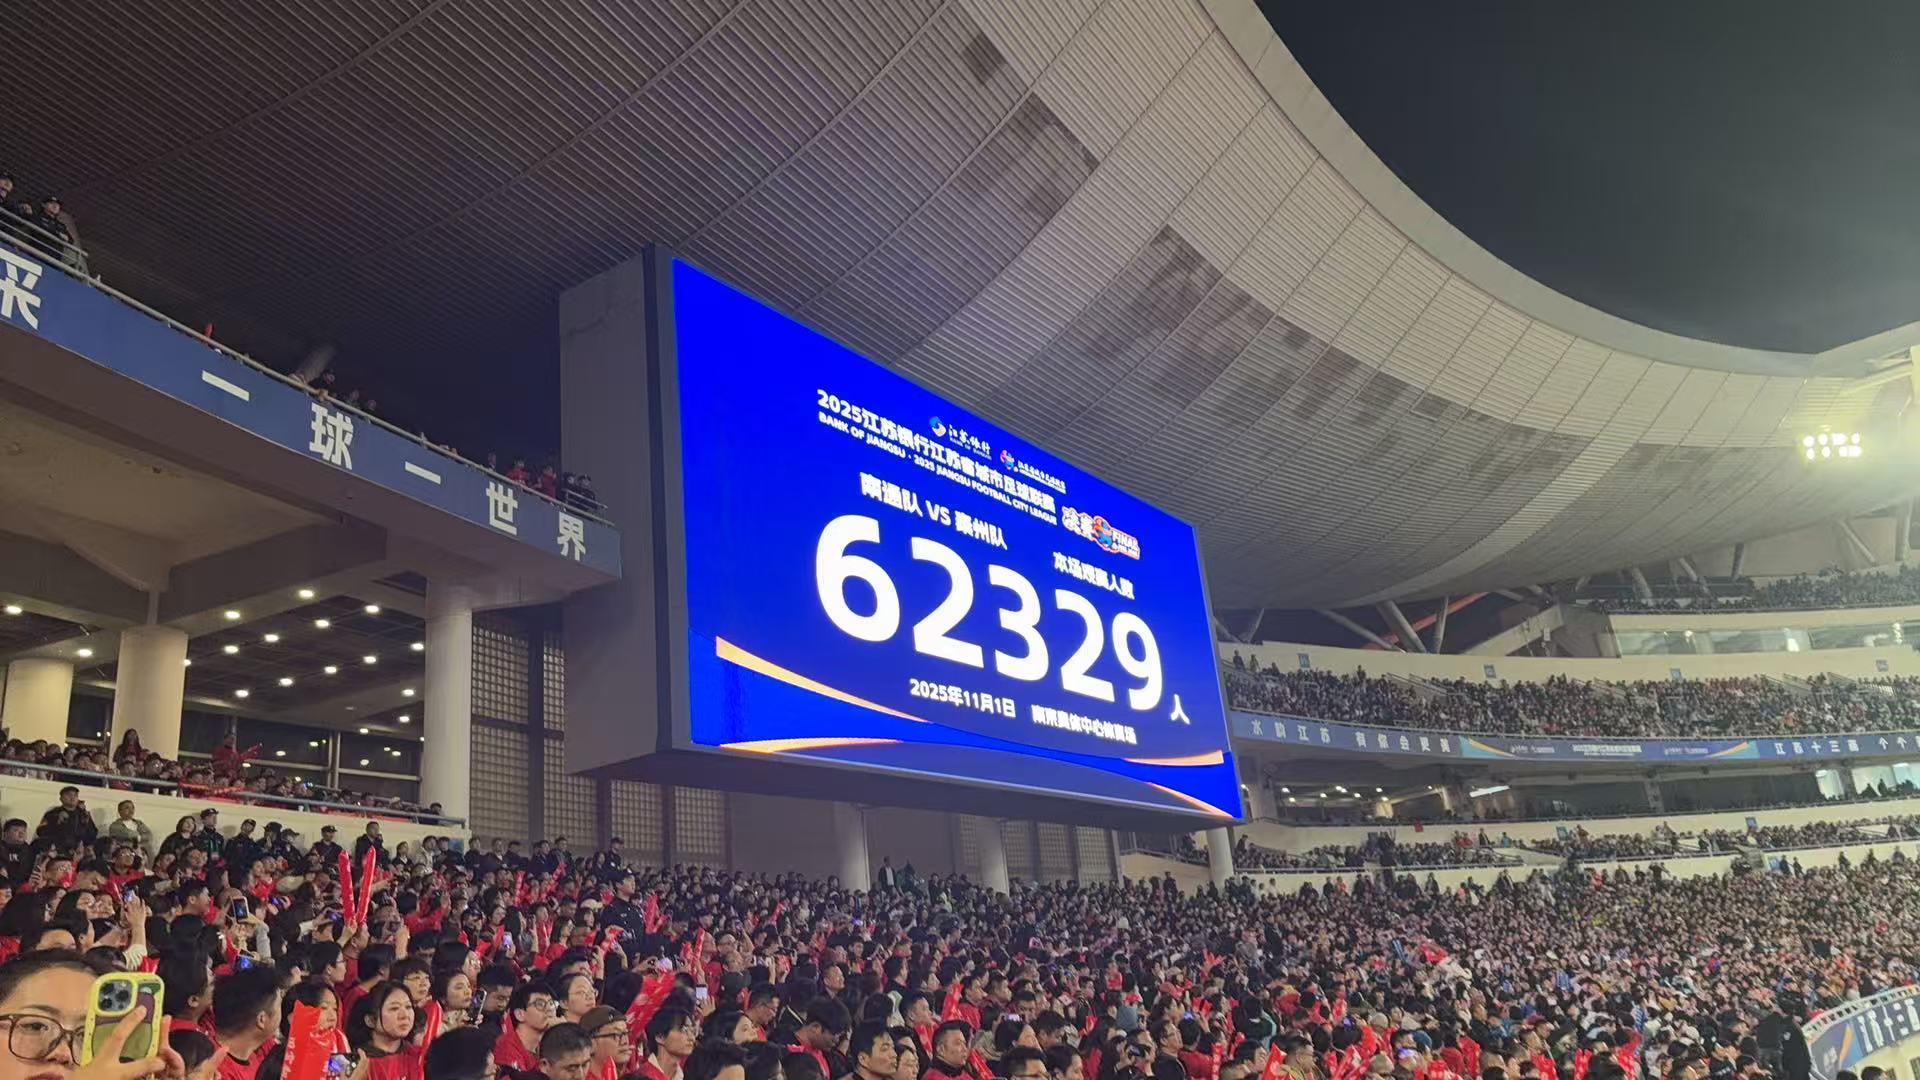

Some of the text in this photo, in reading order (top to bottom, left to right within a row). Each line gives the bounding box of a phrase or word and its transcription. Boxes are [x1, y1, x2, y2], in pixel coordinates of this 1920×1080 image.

[202, 369, 586, 561] 一球一世界
[817, 389, 1056, 514] 2025江苏银行江苏省城市足球联赛
[819, 411, 849, 434] BANK
[850, 426, 865, 440] OF
[866, 433, 906, 459] JIANGSU
[860, 472, 1008, 550] 南通队 VS 泰州队
[816, 515, 1163, 710] 62329
[910, 678, 1017, 718] 2025年11月1日
